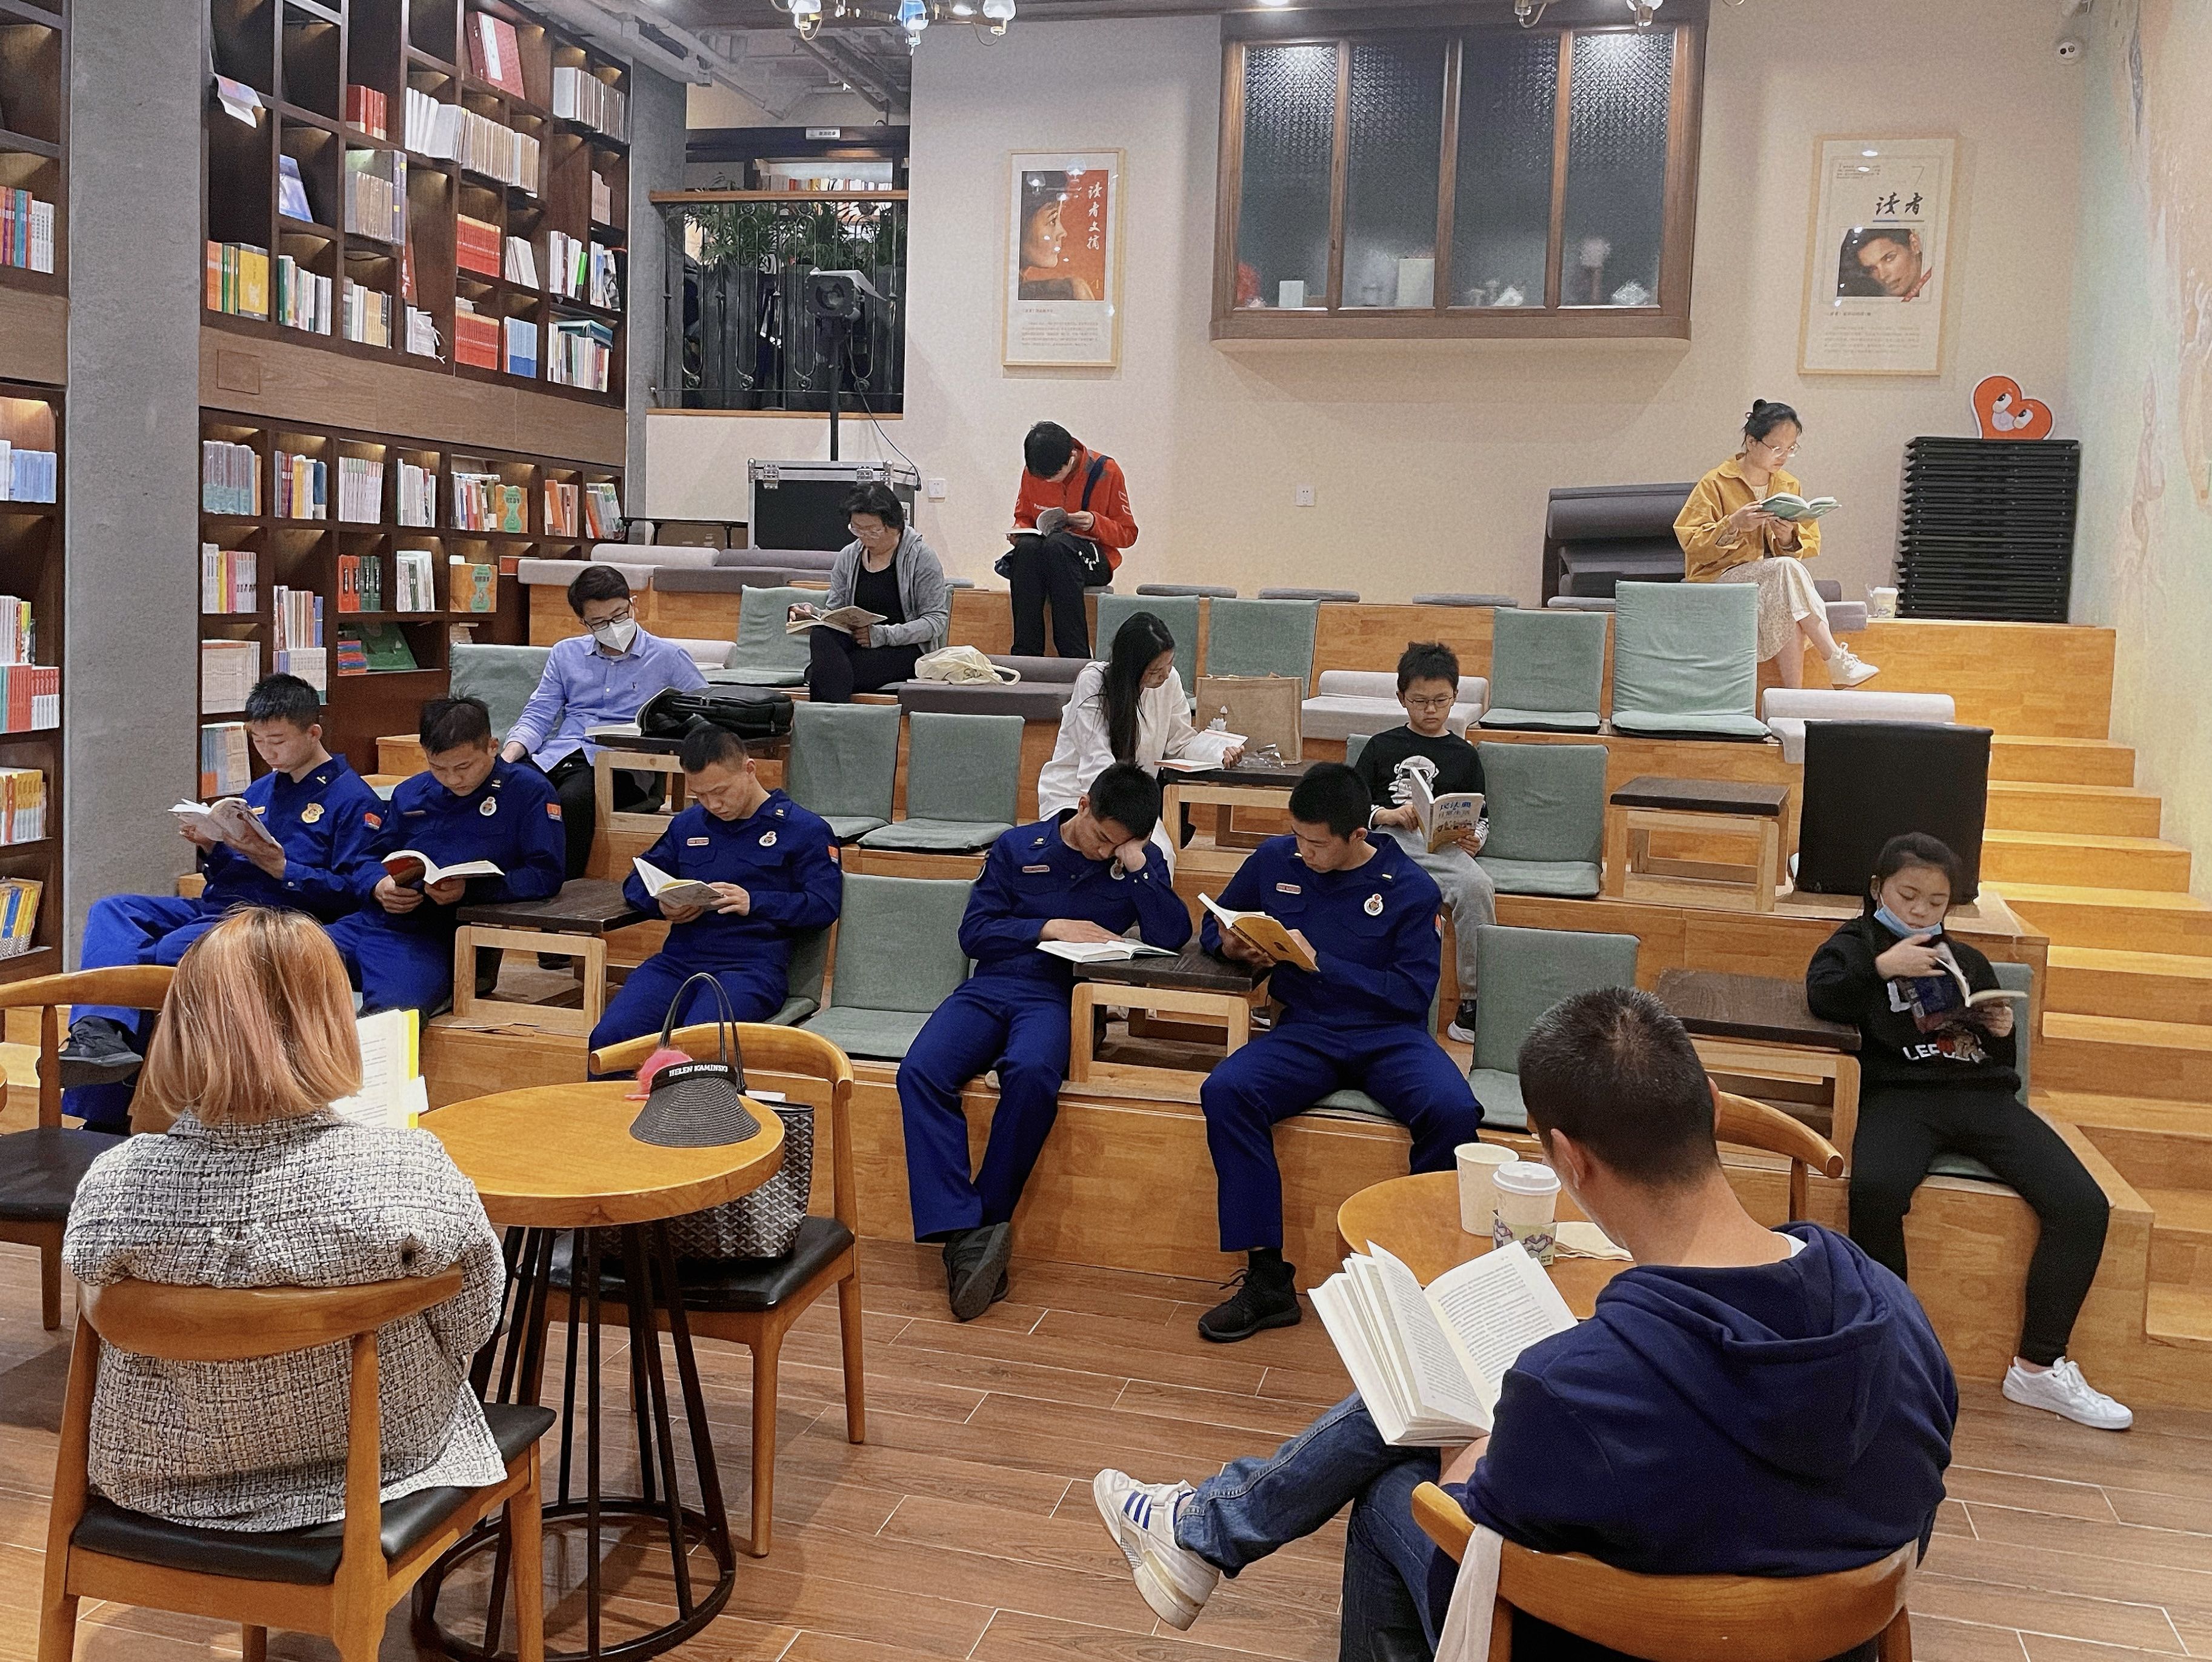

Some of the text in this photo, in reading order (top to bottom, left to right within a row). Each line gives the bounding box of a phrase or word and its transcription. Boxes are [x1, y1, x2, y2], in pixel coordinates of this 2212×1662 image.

[1087, 182, 1102, 250] 读者文摘
[1876, 191, 1924, 216] 读者
[669, 1066, 693, 1076] HELEN
